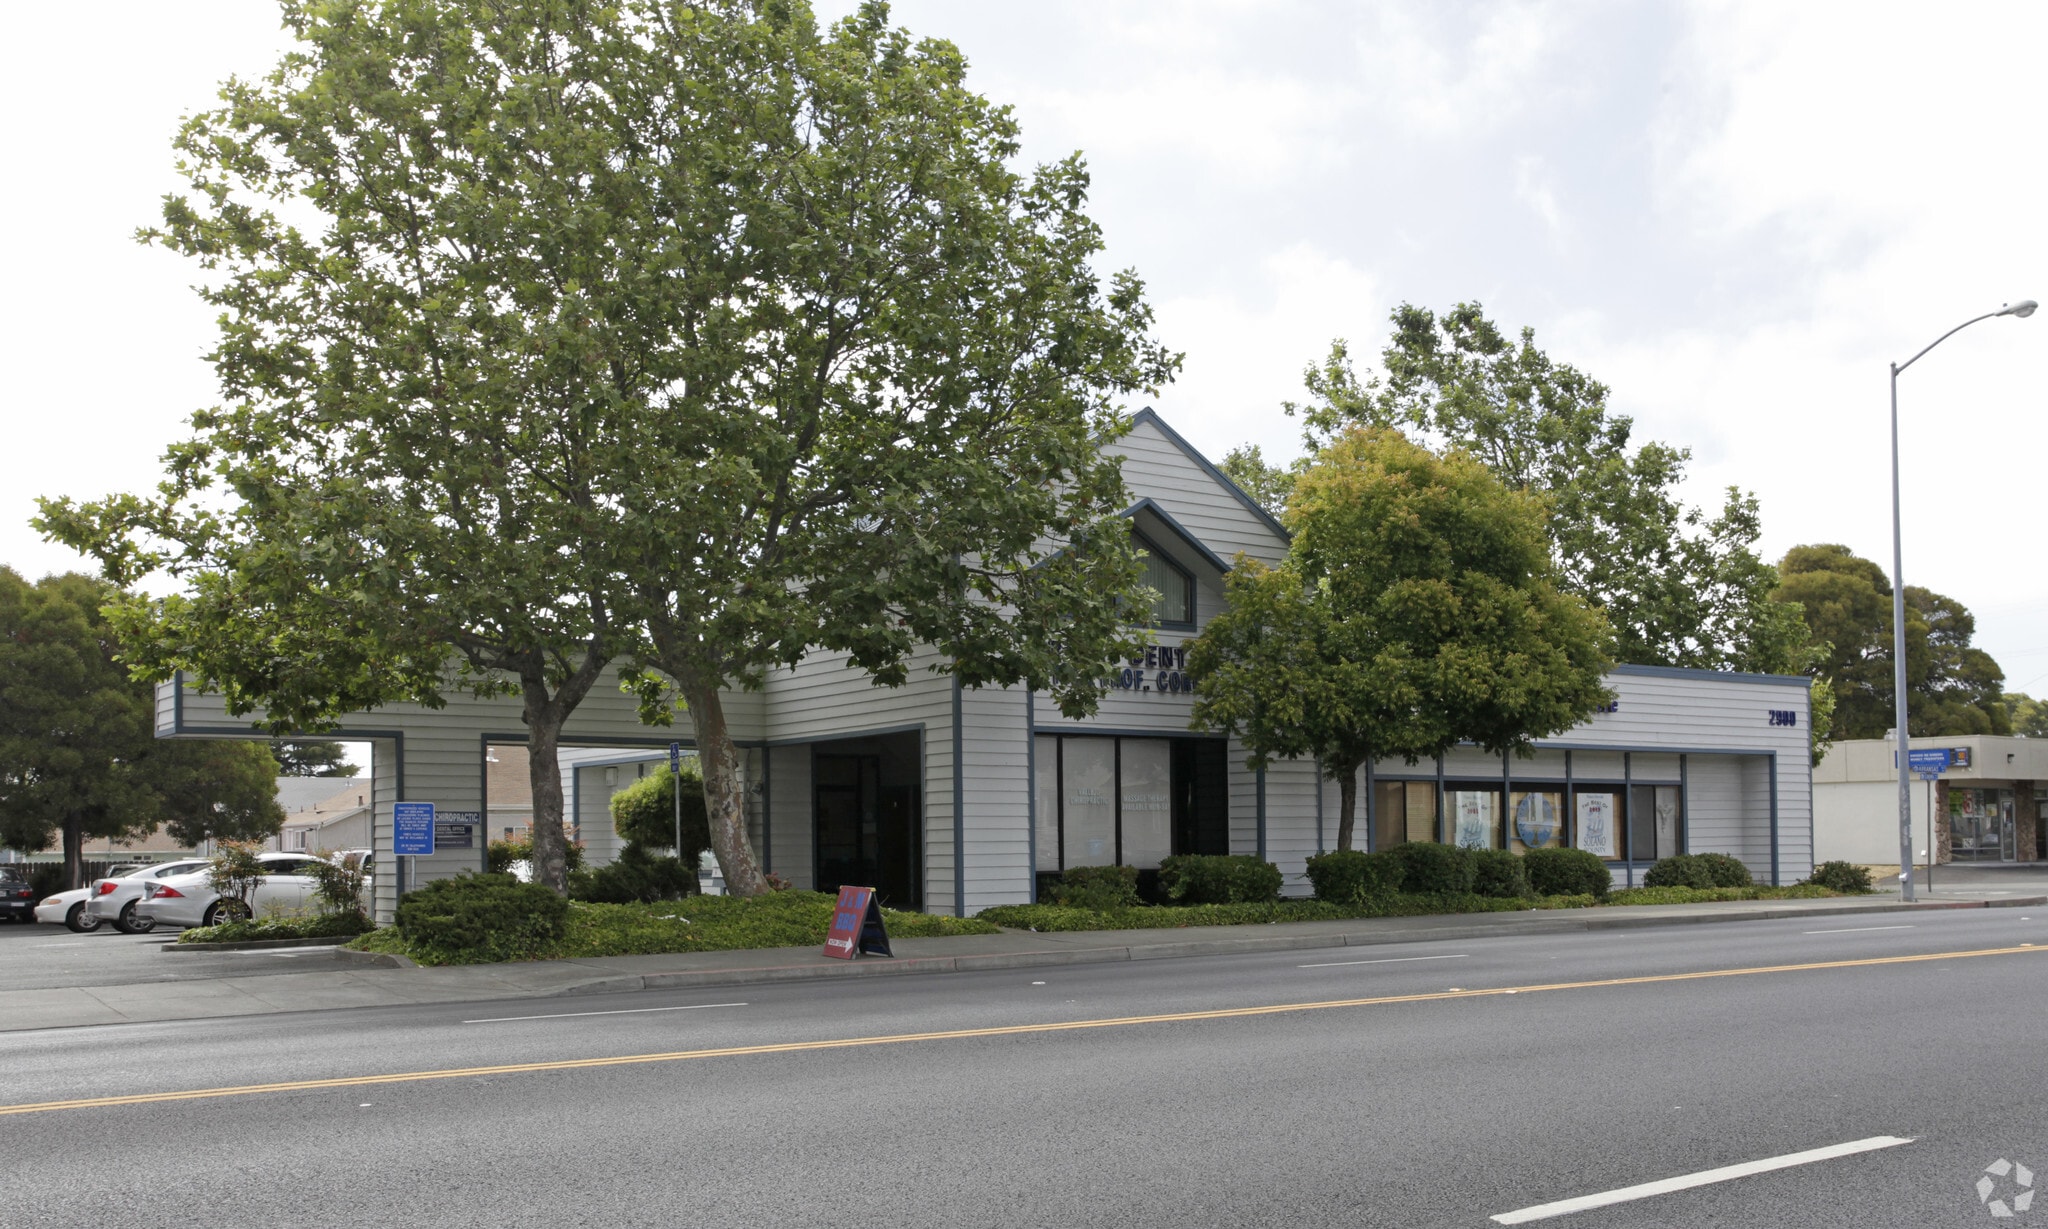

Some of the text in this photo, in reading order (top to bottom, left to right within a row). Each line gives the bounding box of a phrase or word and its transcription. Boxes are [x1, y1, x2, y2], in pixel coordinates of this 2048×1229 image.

[1768, 709, 1796, 727] 2900
[434, 812, 478, 822] CHIROPRACTIC
[835, 912, 857, 932] BBQ
